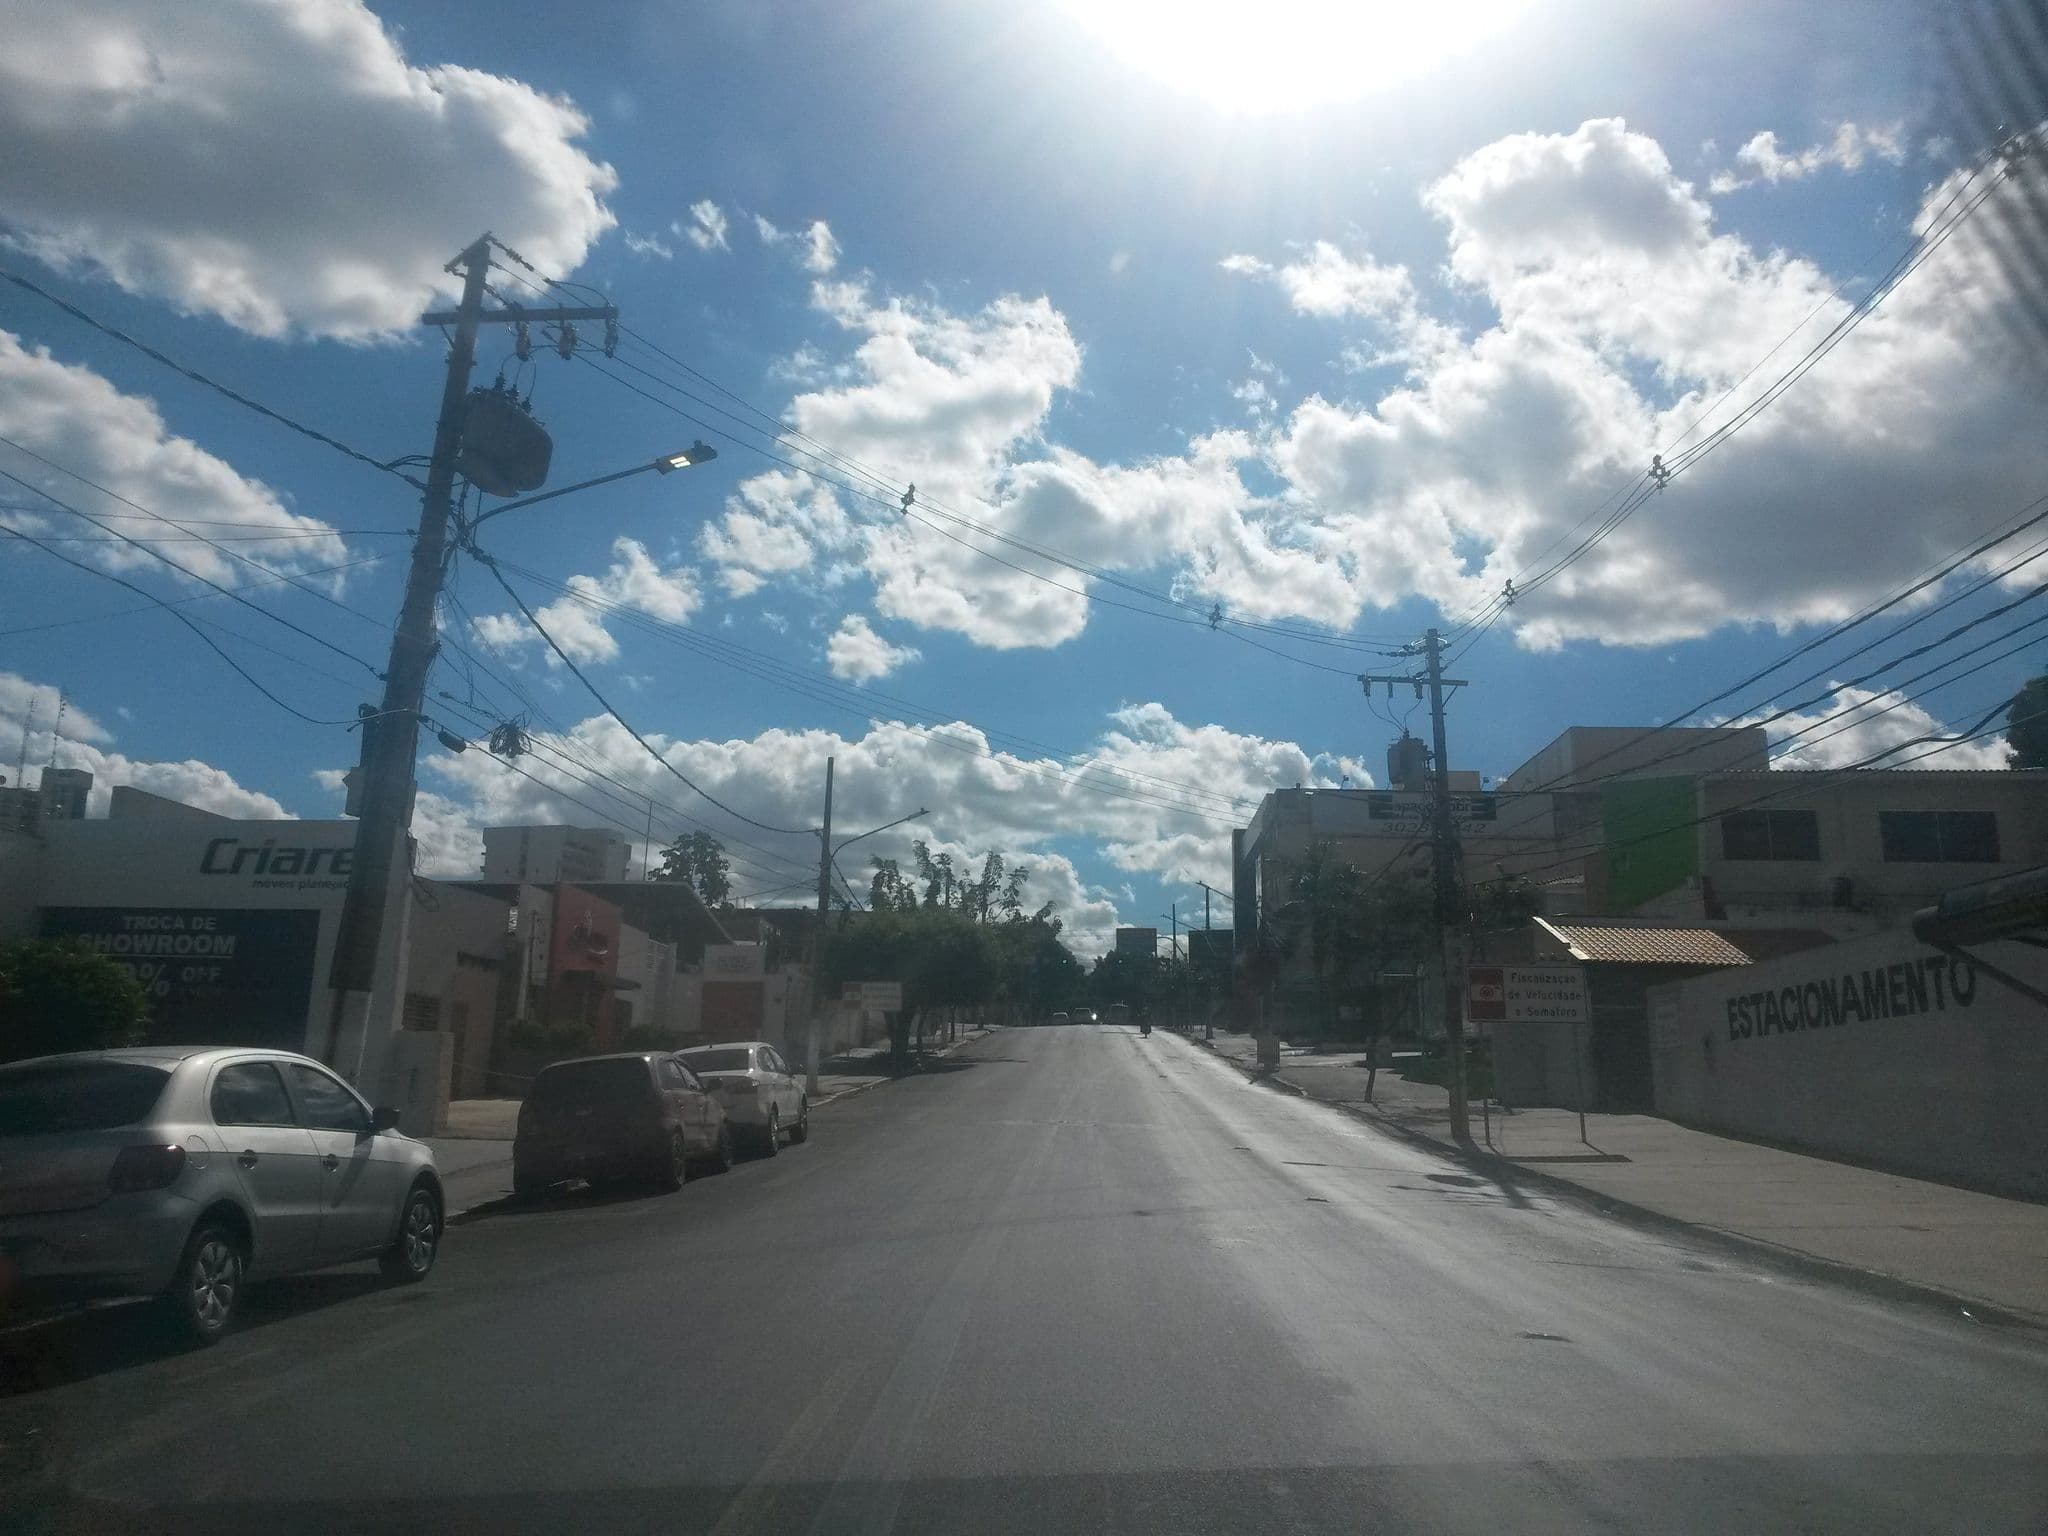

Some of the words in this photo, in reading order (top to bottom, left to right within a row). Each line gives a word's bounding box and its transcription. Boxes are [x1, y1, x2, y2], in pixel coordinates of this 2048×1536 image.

[200, 837, 353, 874] Criare
[122, 915, 185, 931] TROCA
[191, 915, 217, 931] DE
[78, 933, 236, 954] SHOWROOM
[182, 967, 223, 981] OFF
[1507, 990, 1521, 1001] de
[1526, 990, 1582, 1001] Velocidade
[1726, 955, 1976, 1041] ESTACIONAMENTO
